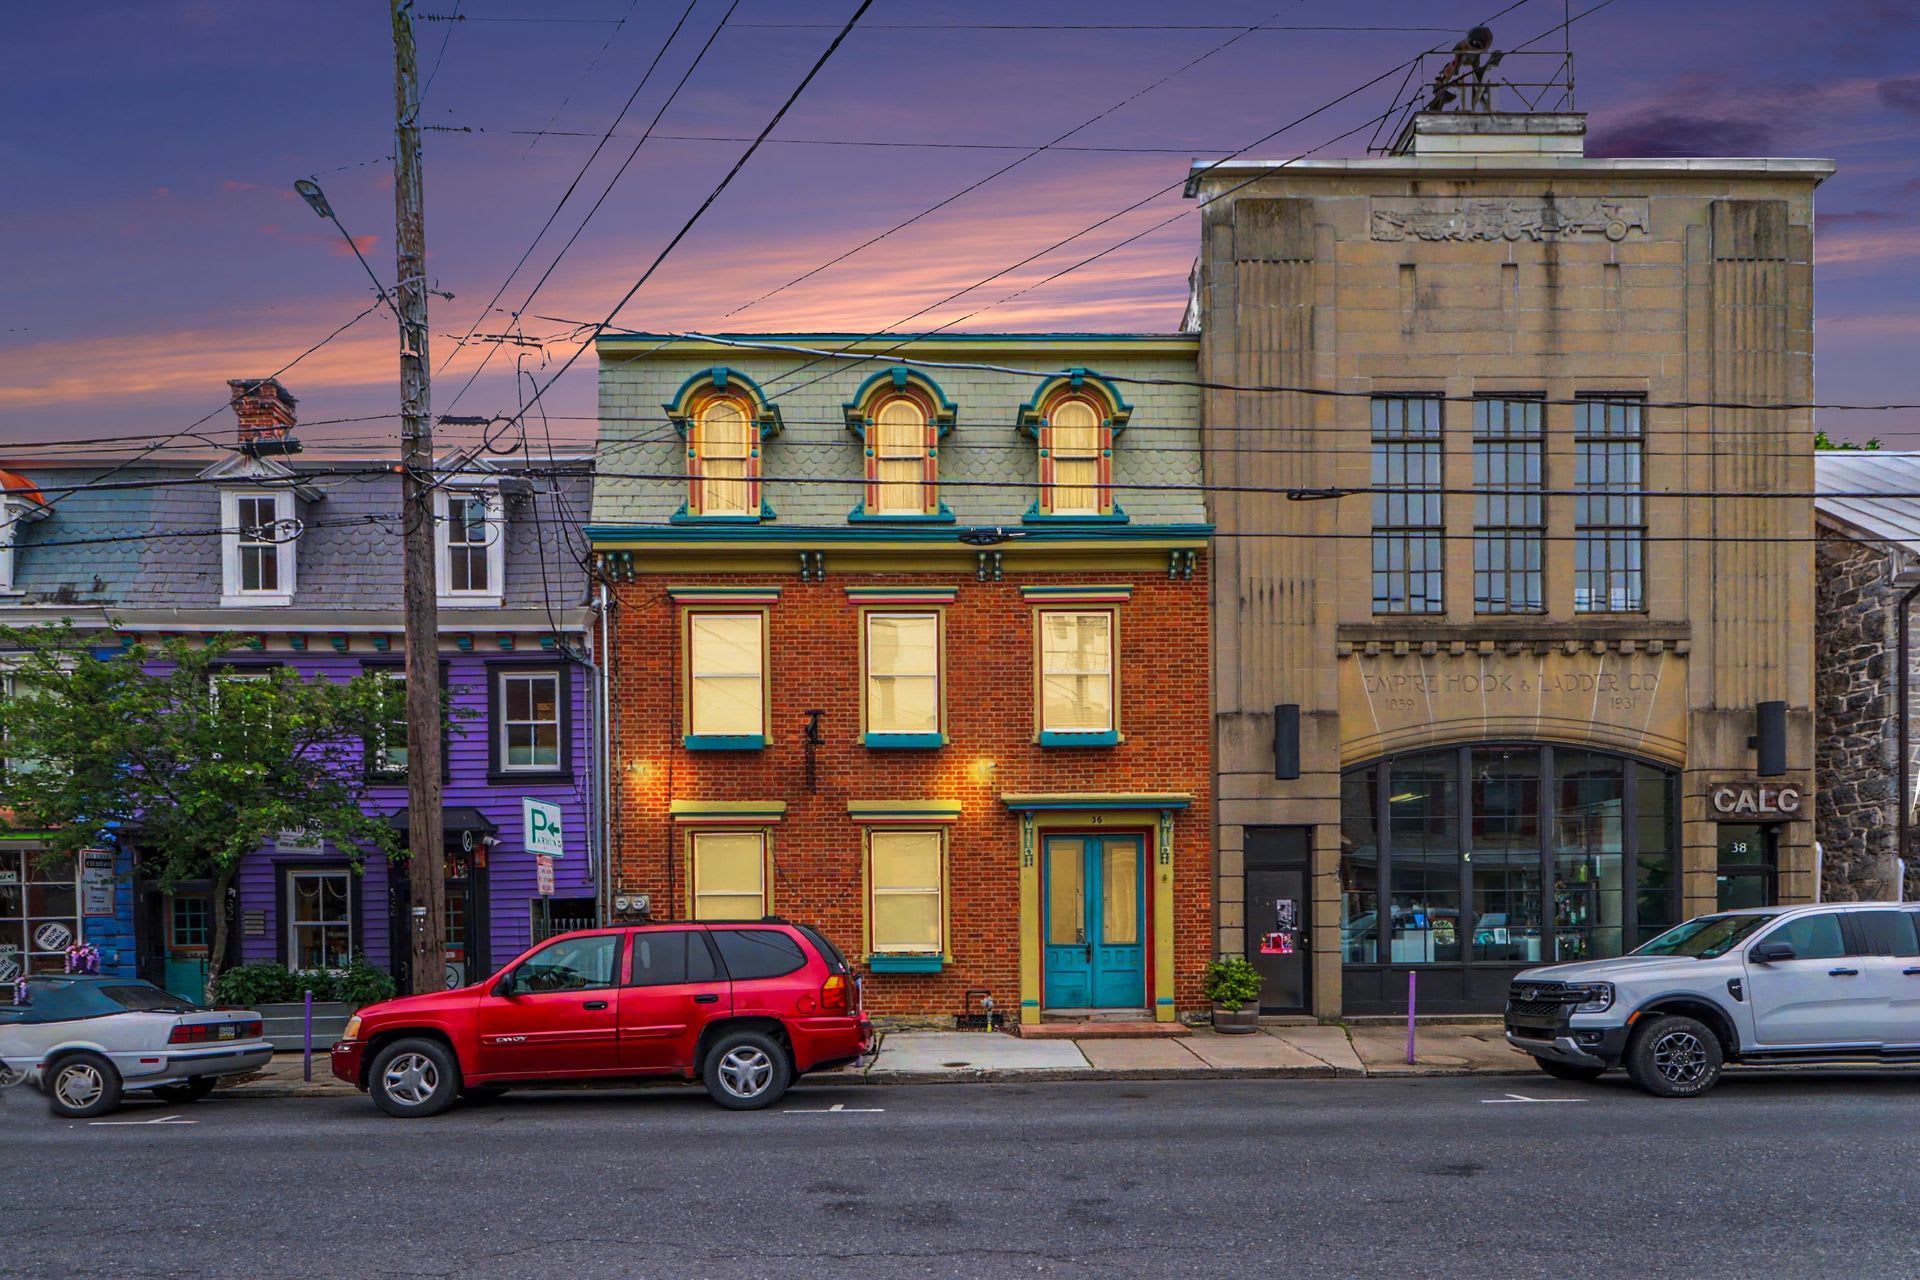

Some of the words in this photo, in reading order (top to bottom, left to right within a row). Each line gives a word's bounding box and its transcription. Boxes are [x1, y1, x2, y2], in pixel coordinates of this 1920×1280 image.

[1363, 675, 1438, 693] EMPIRE
[1446, 674, 1512, 693] HOOK
[1538, 674, 1619, 692] LADDER
[1627, 674, 1658, 692] CO
[1714, 788, 1799, 813] CALC
[1091, 815, 1103, 824] 36
[1731, 842, 1747, 853] 38
